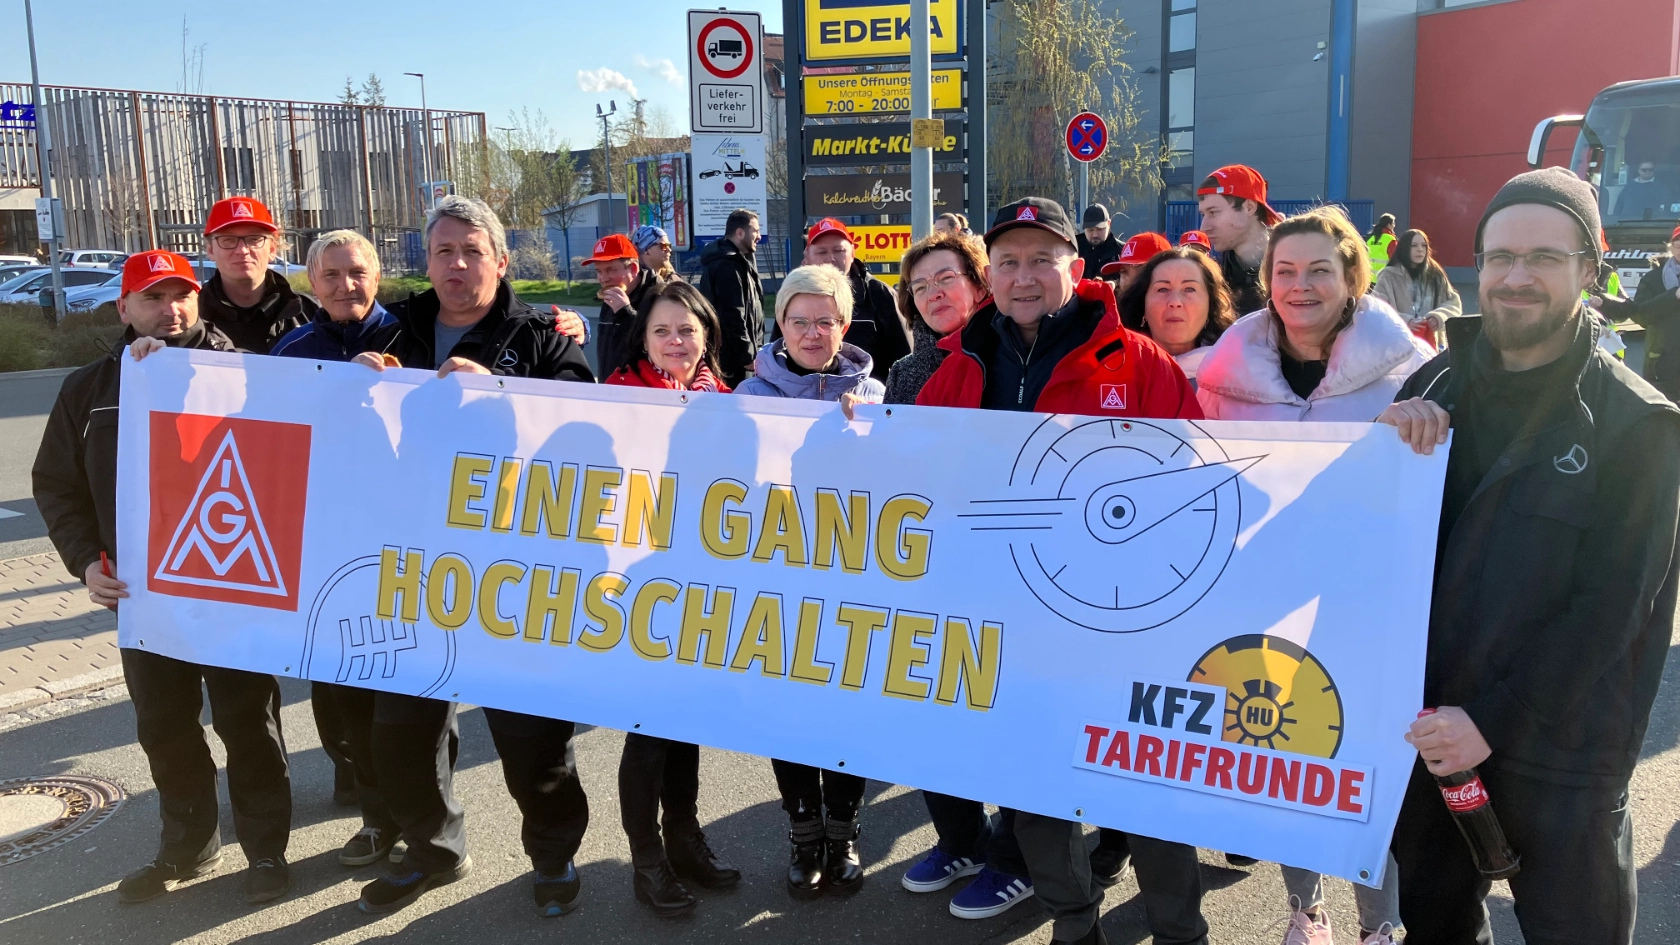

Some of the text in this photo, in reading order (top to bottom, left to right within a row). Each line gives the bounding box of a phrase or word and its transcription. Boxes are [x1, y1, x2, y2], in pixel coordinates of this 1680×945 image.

[820, 15, 943, 44] EDEKA
[818, 74, 949, 88] Unsere Öffnungsten
[709, 89, 744, 99] Liefer-
[840, 90, 872, 98] Montag
[881, 87, 912, 97] Samsta
[707, 101, 747, 111] verkehr
[826, 100, 854, 112] 7:00
[871, 98, 910, 110] 20:00
[719, 113, 736, 123] frei
[811, 133, 957, 156] Markt-Küe
[881, 186, 941, 203] Bäcr
[865, 232, 911, 250] LOTT
[446, 451, 934, 582] EINEN GANG
[375, 544, 1004, 712] HOCHSCHALTEN
[1127, 681, 1216, 736] KFZ
[1246, 705, 1274, 727] HU
[1083, 724, 1366, 814] TARIFRUNDE
[1442, 780, 1480, 802] Coca-Cola
